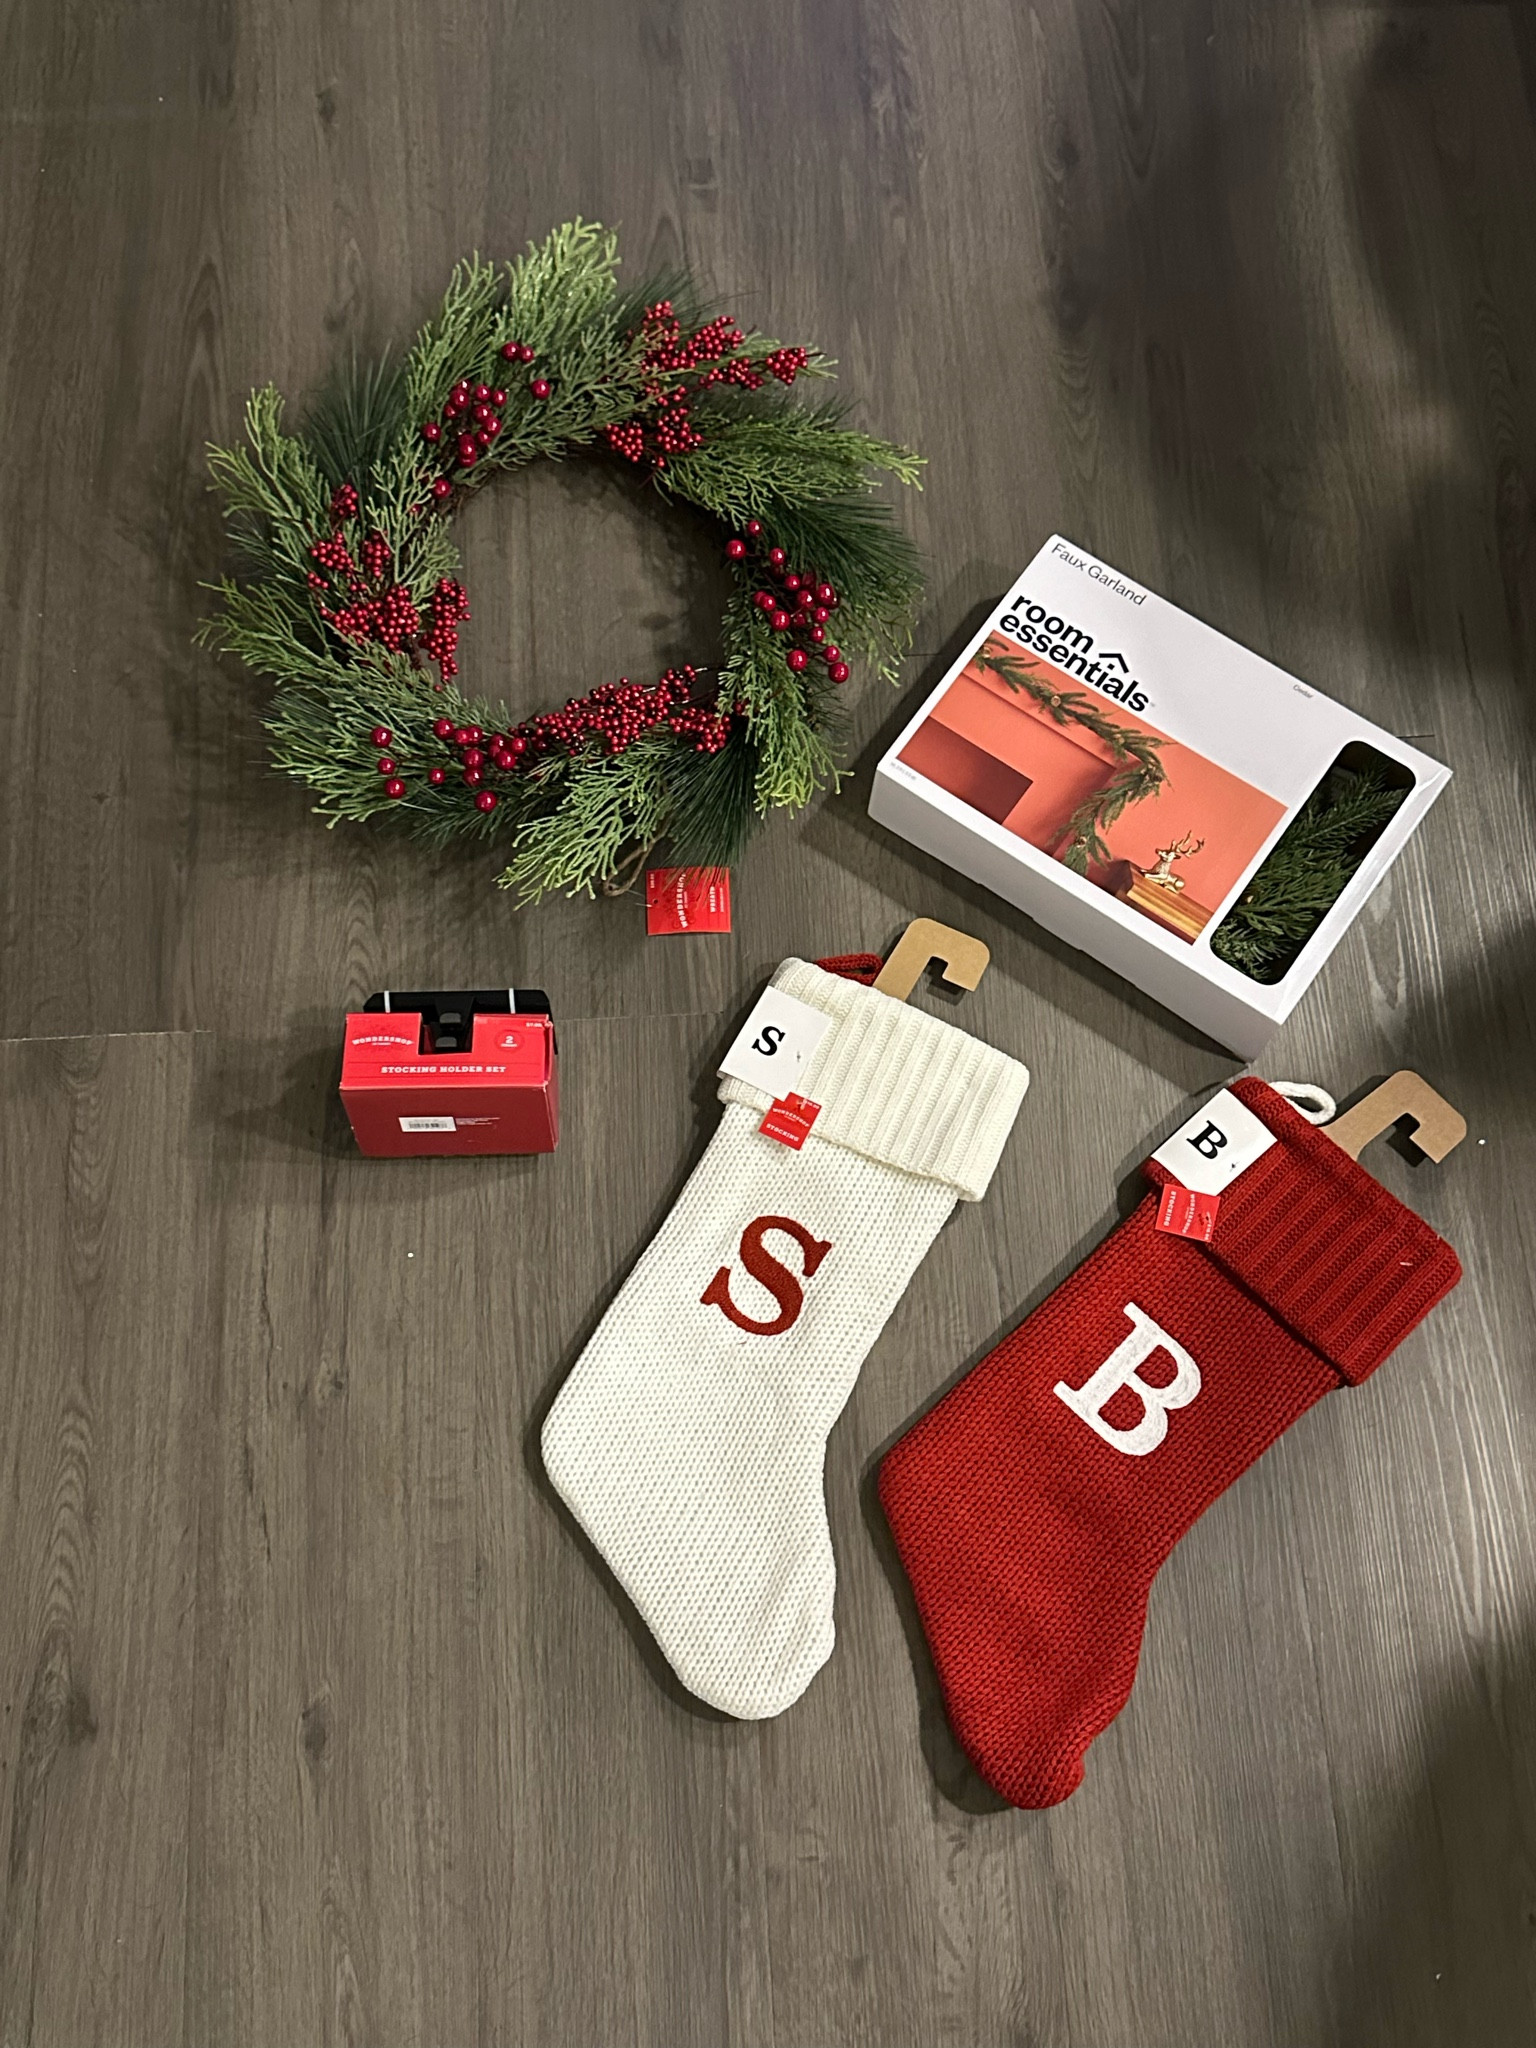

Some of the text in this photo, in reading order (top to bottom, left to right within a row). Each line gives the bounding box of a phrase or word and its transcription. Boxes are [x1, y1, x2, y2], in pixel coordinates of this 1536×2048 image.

[1051, 543, 1147, 606] Faux Garland
[1010, 595, 1094, 654] room
[999, 614, 1150, 712] essentials
[352, 1036, 413, 1045] WONDERSHOP
[505, 1035, 514, 1044] 2
[751, 1025, 786, 1056] S
[766, 1123, 800, 1142] STOCKING
[1186, 1119, 1228, 1160] B
[1163, 1191, 1177, 1227] STOCKING
[700, 1215, 832, 1336] S
[1053, 1301, 1201, 1456] B
